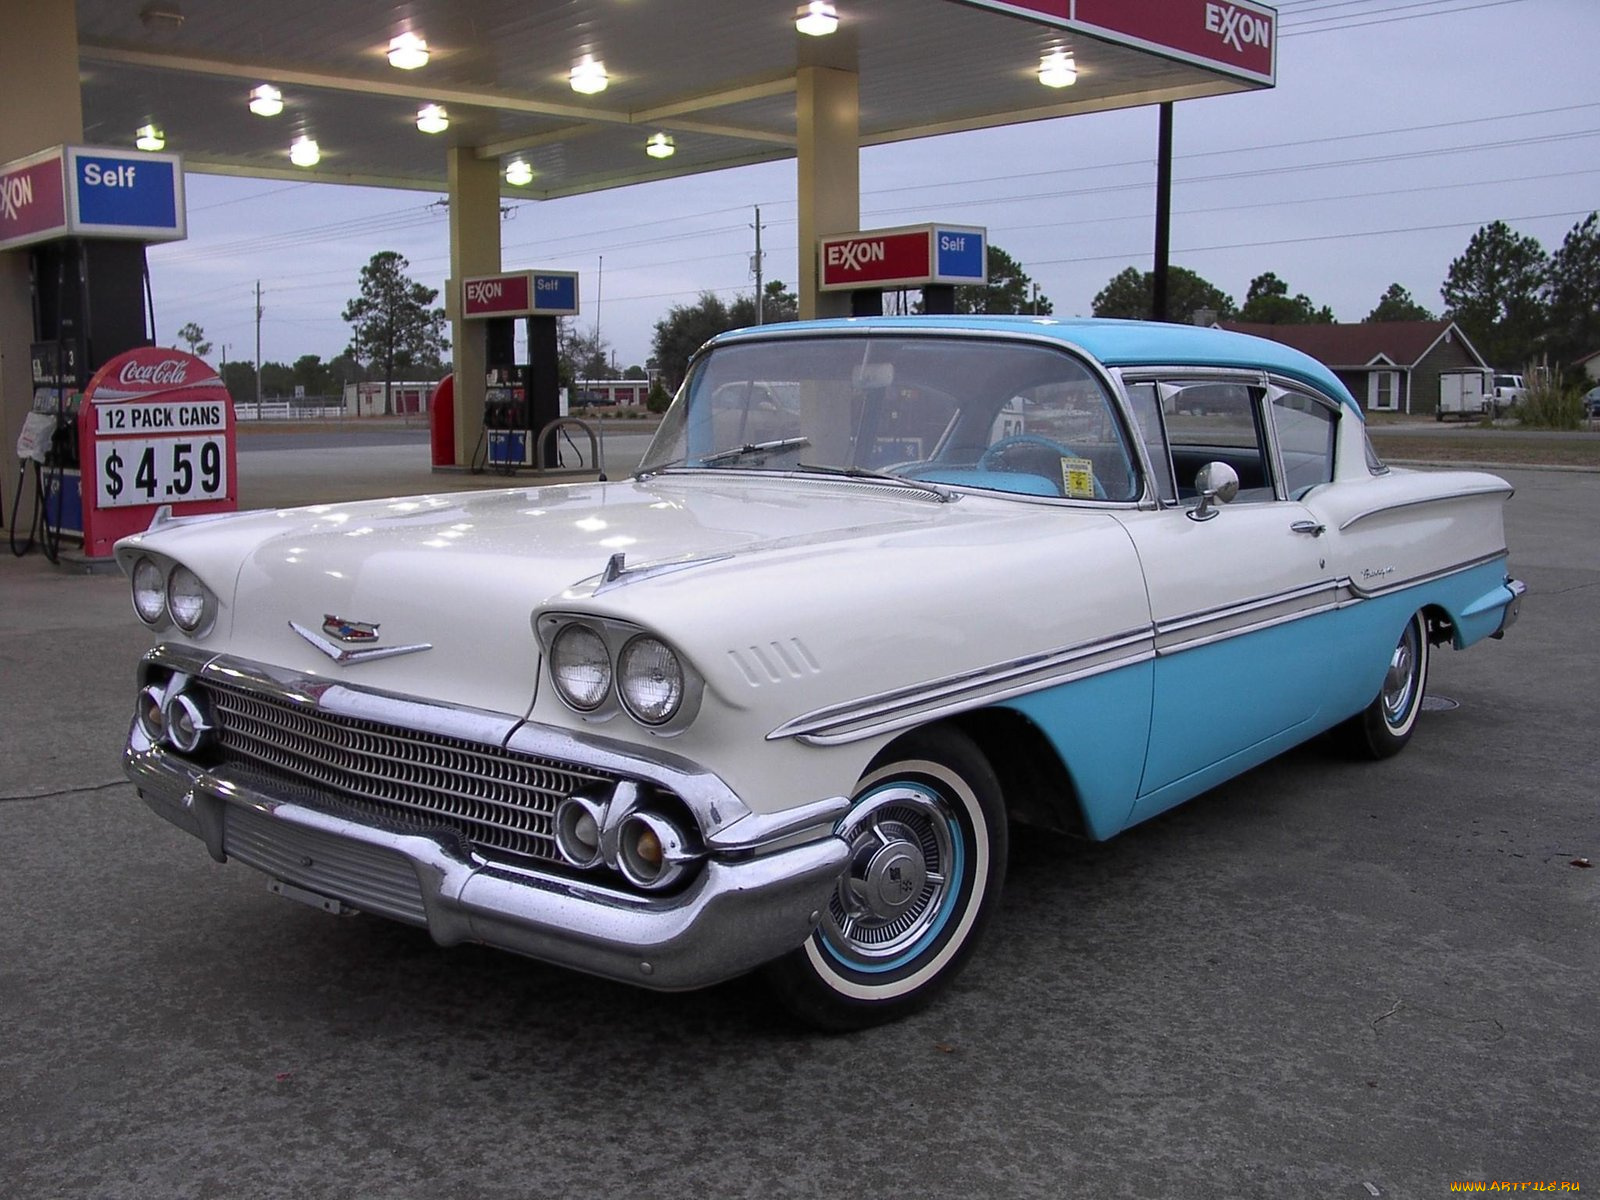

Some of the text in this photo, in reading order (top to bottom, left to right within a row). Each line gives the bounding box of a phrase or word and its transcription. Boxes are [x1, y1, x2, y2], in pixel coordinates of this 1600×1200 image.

[1205, 2, 1269, 52] EXXON
[84, 163, 136, 188] Self
[941, 236, 966, 252] Self
[828, 241, 885, 271] EXXON
[467, 282, 502, 304] EXXON
[537, 279, 559, 291] Self
[119, 360, 190, 384] Coca-Cola
[106, 406, 220, 429] 12 PACK CANS
